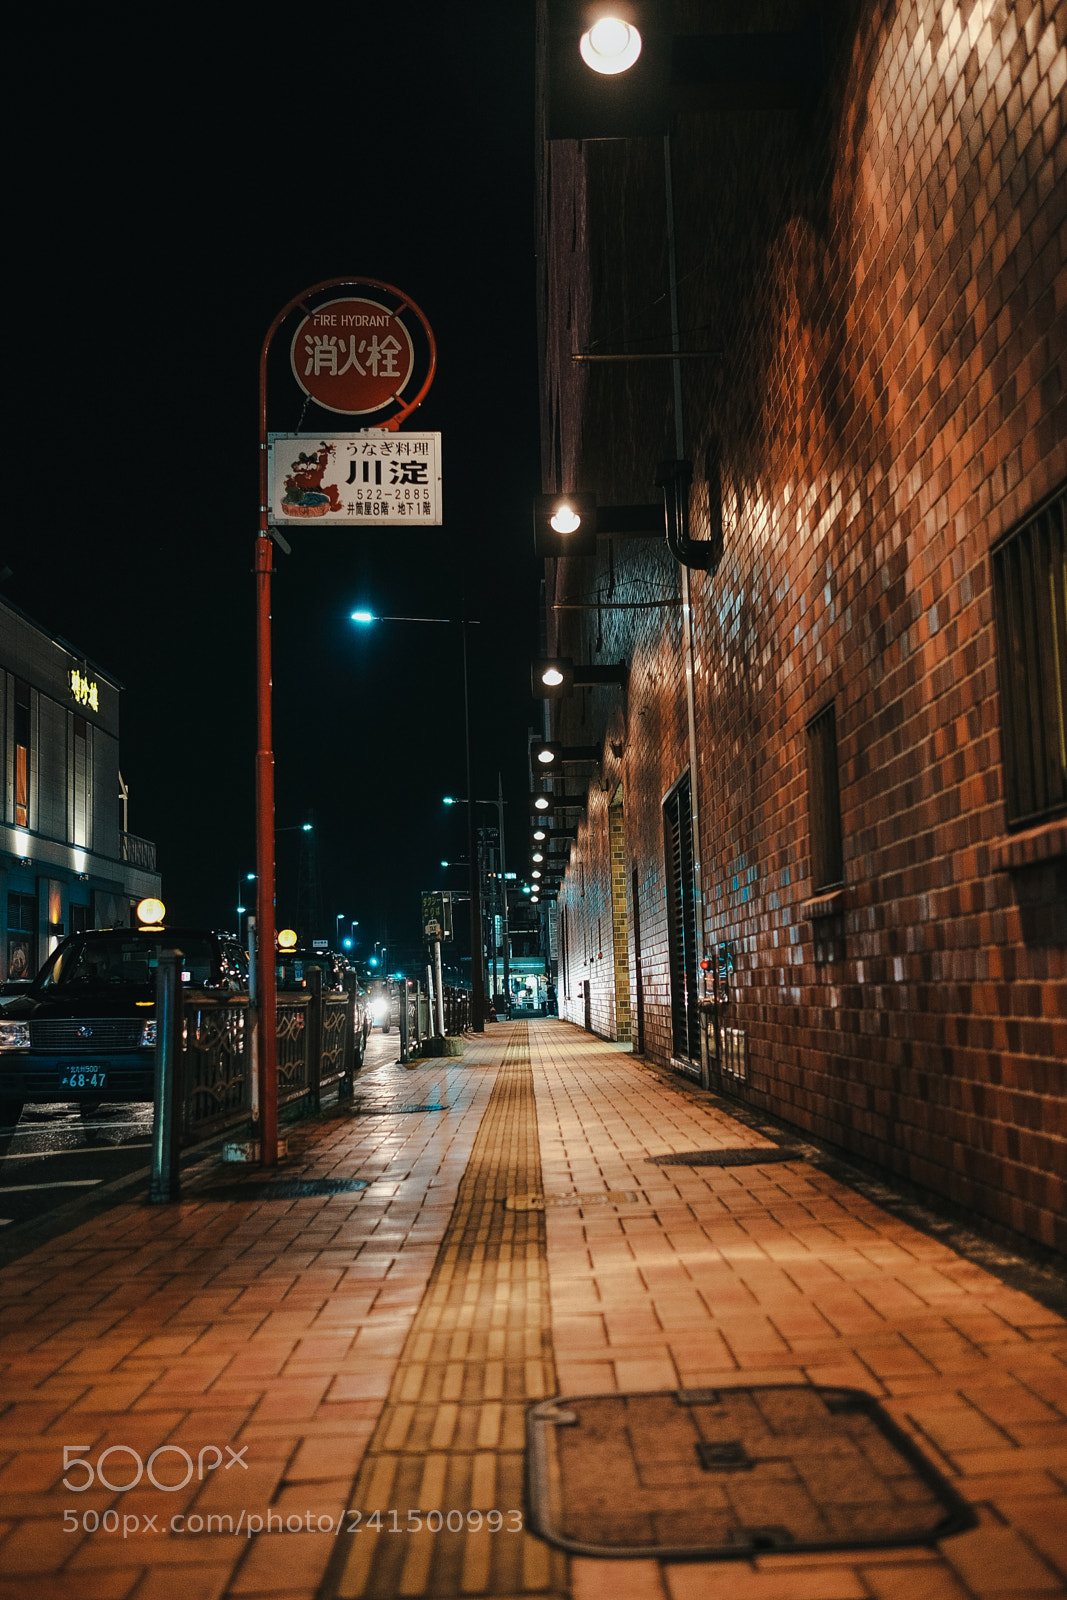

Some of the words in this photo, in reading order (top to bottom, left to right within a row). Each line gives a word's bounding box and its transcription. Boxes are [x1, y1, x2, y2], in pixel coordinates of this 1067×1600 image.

[313, 315, 337, 327] FIRE
[341, 314, 390, 327] HYDRANT
[304, 334, 402, 377] 消火栓
[346, 441, 429, 456] うなぎ料理
[345, 460, 429, 485] 川淀
[357, 489, 430, 500] 522-2885
